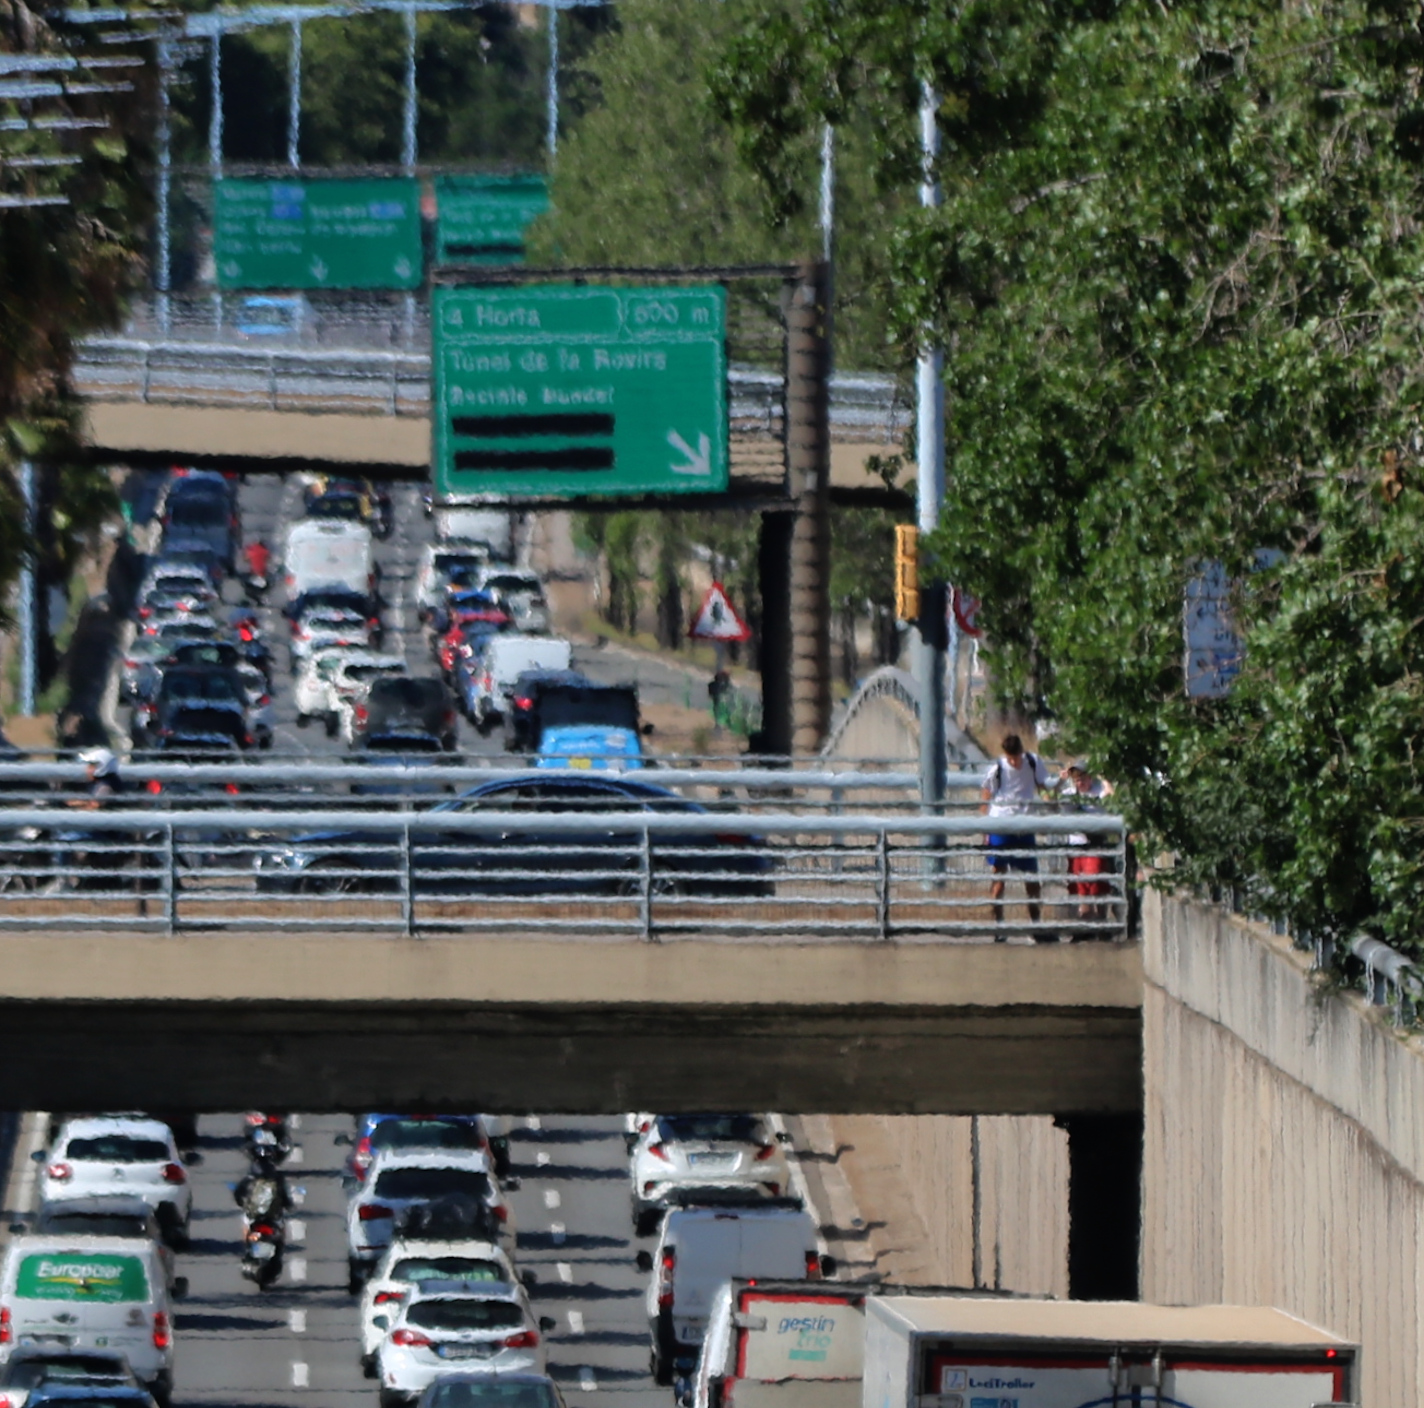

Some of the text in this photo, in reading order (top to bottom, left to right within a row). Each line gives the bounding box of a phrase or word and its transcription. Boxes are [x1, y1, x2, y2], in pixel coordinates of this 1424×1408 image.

[476, 305, 542, 327] Horta
[691, 306, 710, 325] m
[519, 350, 550, 373] de
[558, 349, 581, 372] la
[594, 349, 668, 372] Rovira
[37, 1261, 125, 1279] Europcar
